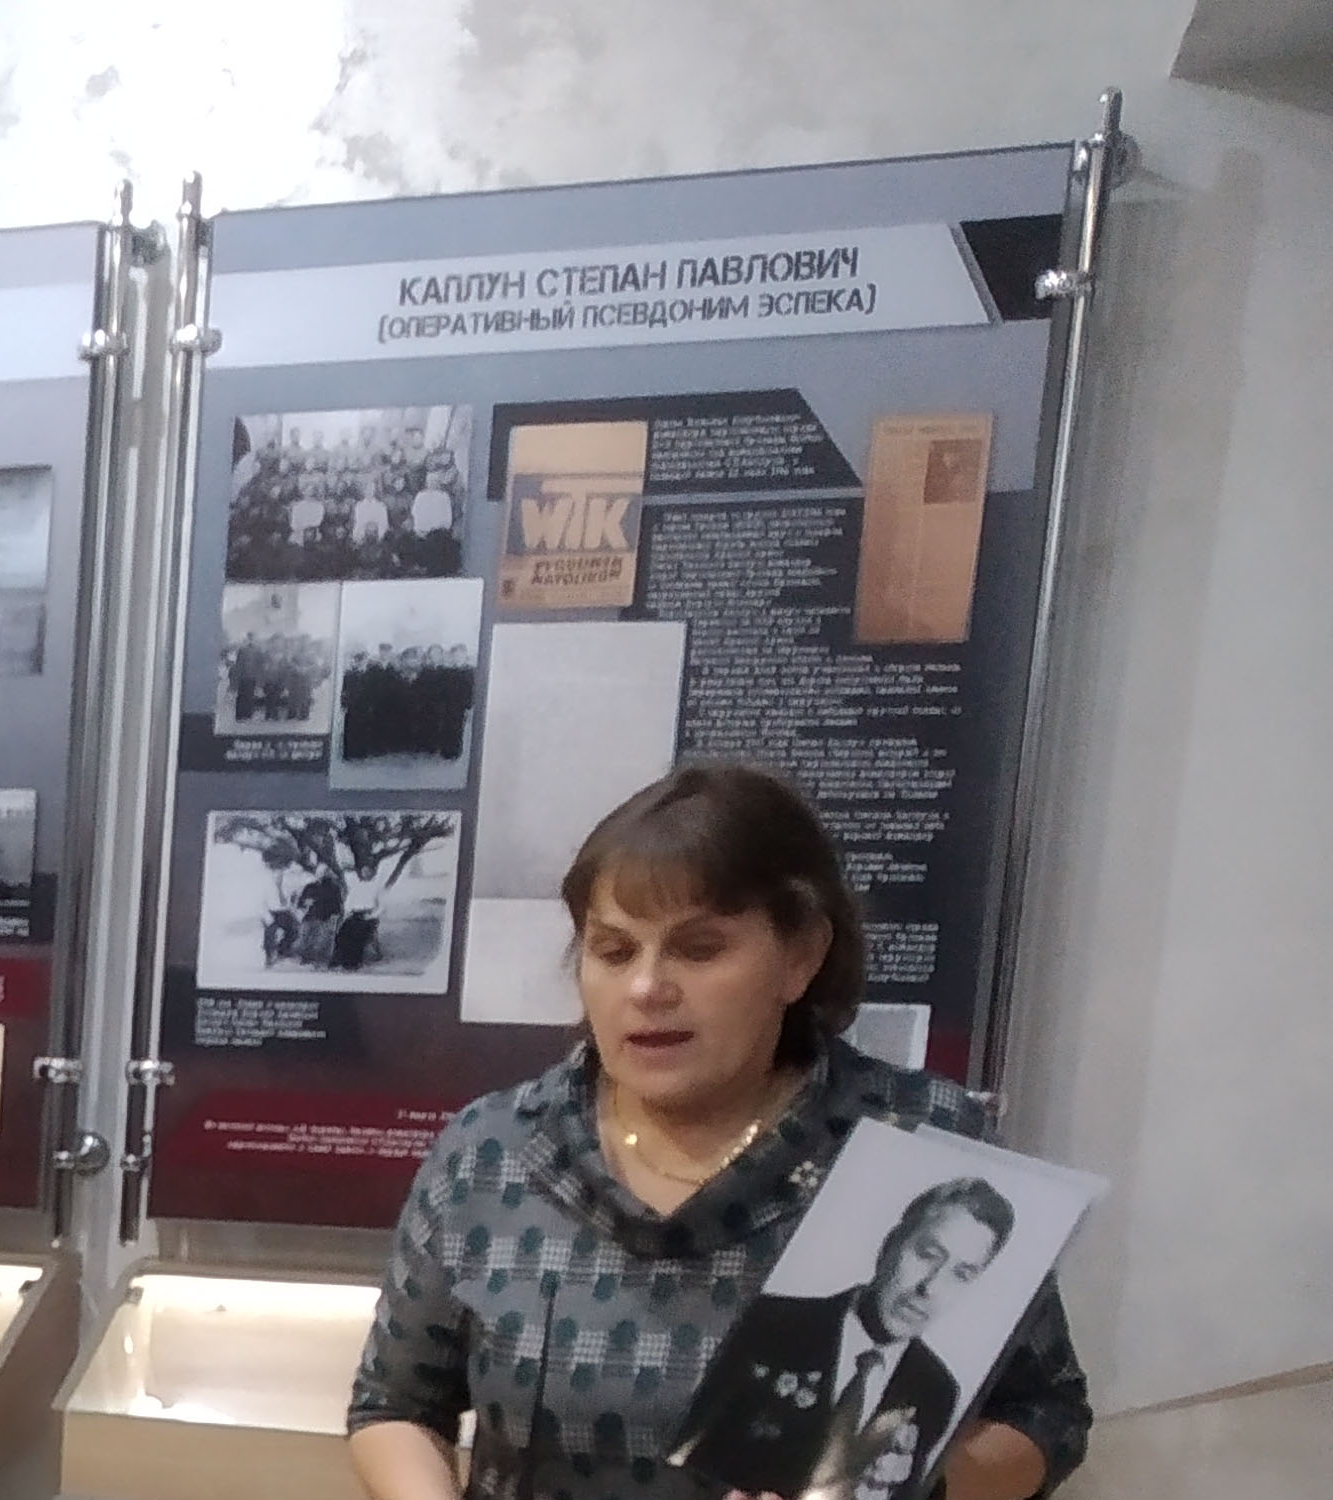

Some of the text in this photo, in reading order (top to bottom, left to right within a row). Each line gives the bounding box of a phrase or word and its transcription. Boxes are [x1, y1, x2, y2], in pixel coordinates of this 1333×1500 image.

[399, 246, 861, 306] КАПЛУН СТЕПАН ПАВЛОВИЧ
[581, 294, 750, 329] ПСЕВДОНИМ
[520, 479, 643, 550] WTK
